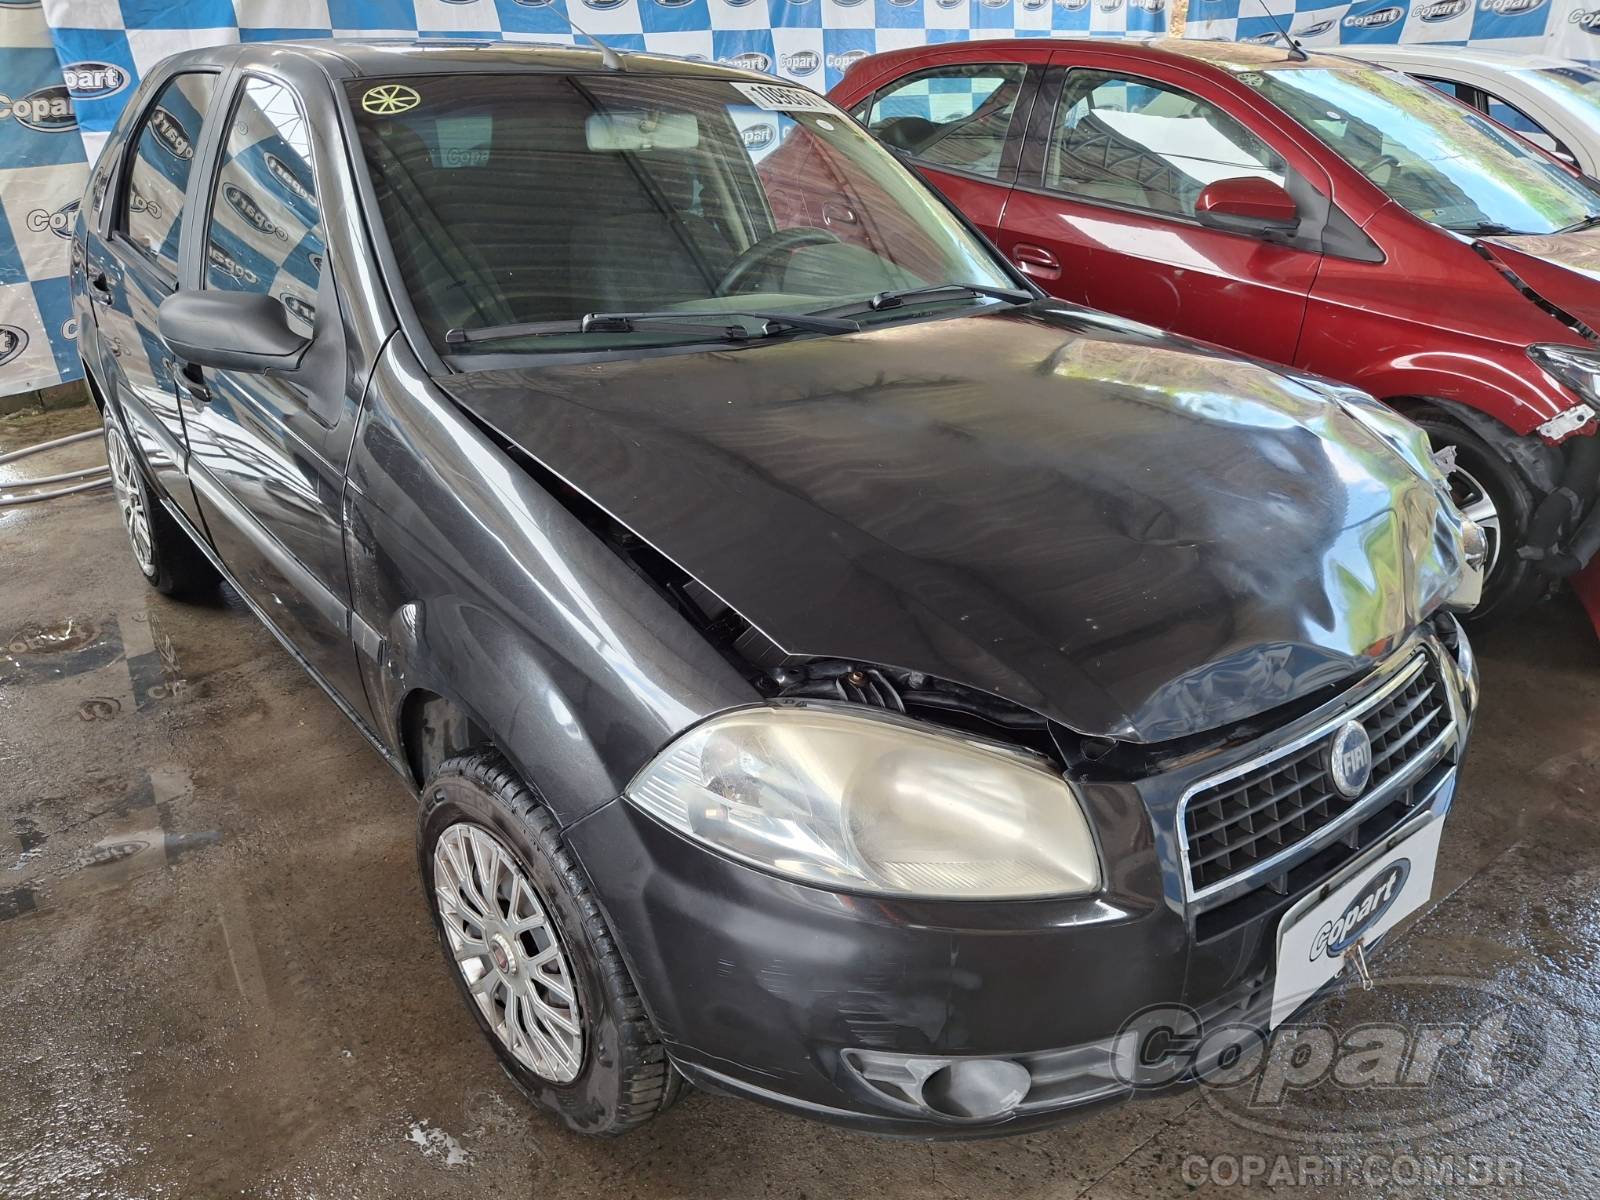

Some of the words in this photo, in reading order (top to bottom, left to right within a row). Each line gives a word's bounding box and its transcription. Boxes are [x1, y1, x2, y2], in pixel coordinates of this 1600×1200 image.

[1411, 0, 1462, 17] Copart
[1344, 9, 1398, 27] Copart
[780, 53, 817, 72] Copart
[1309, 869, 1398, 962] Copart
